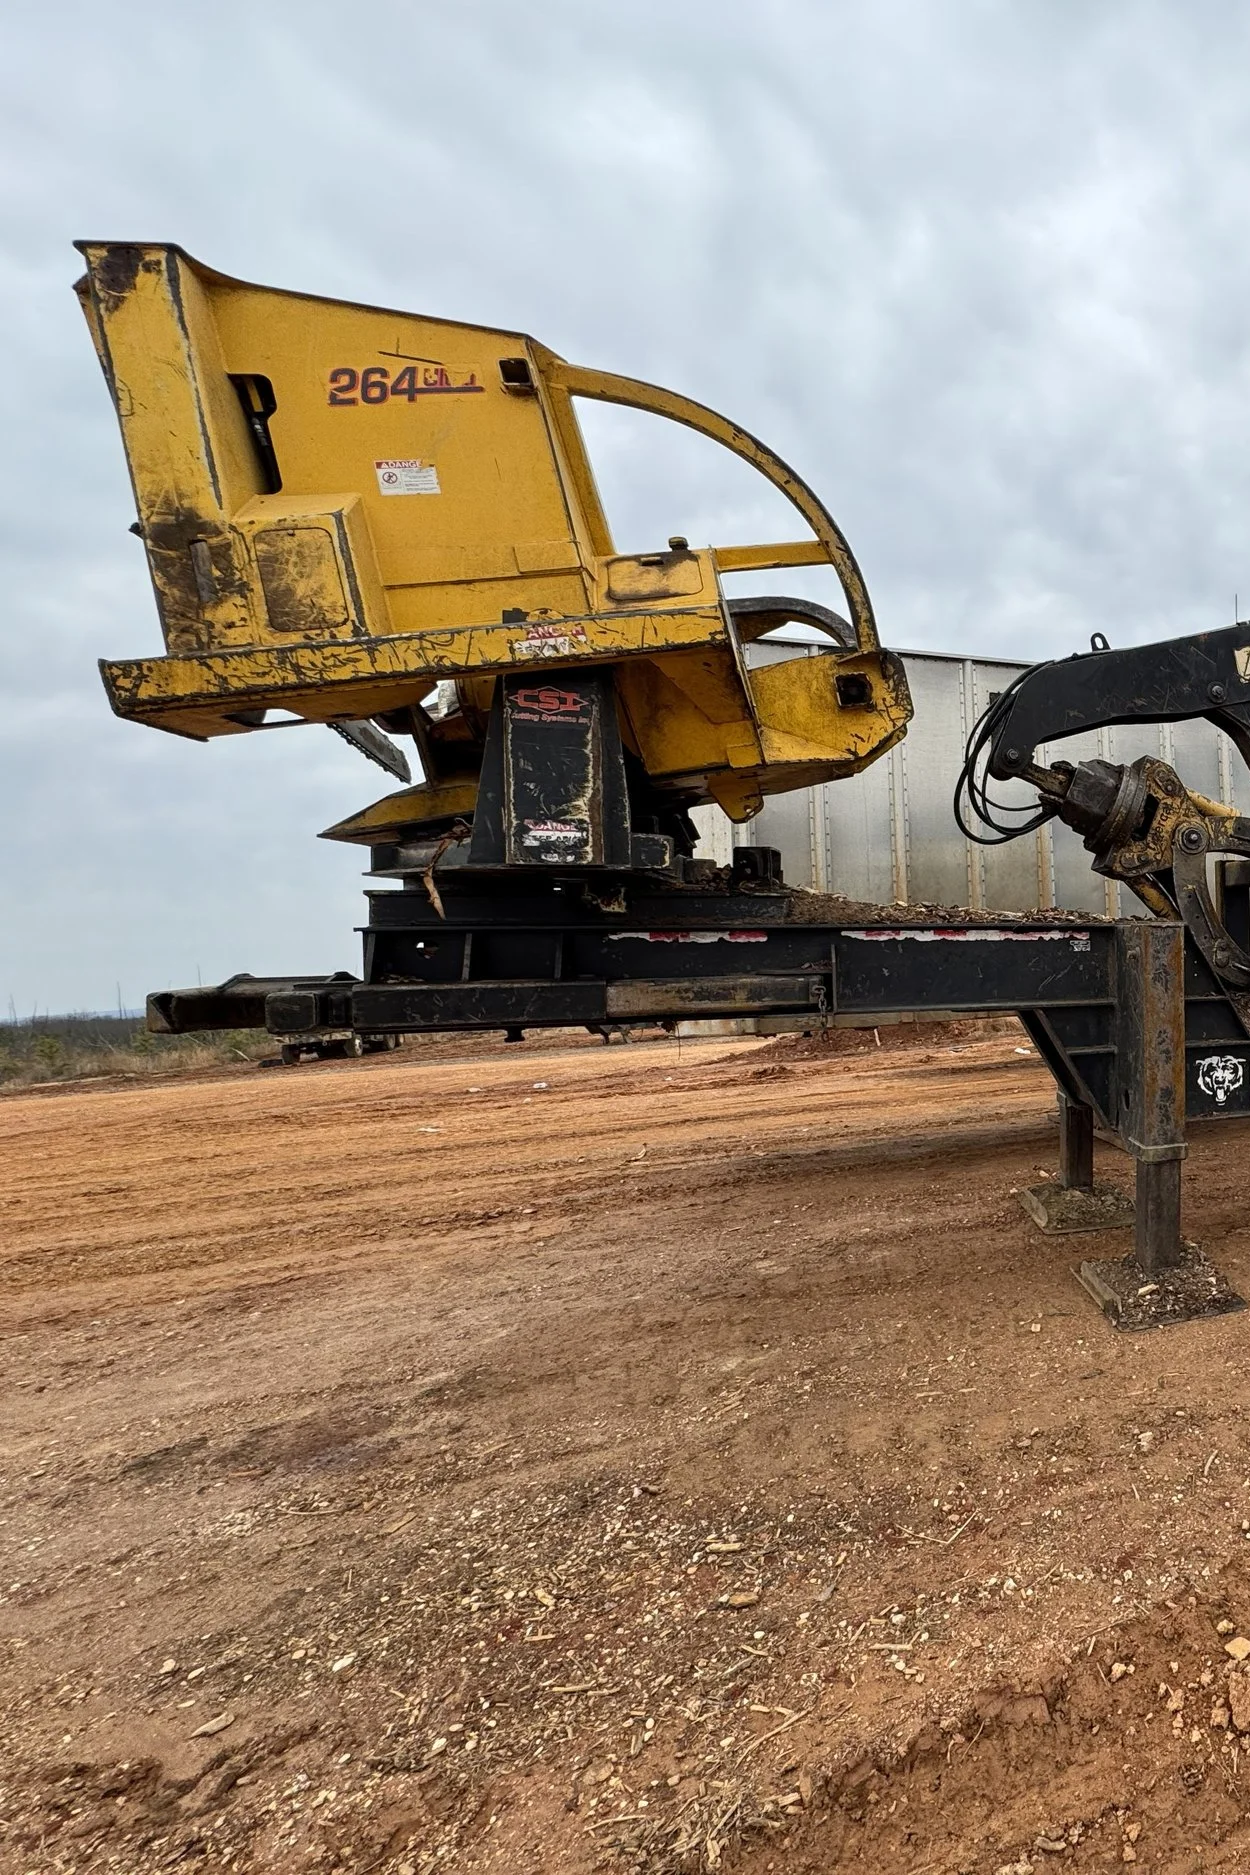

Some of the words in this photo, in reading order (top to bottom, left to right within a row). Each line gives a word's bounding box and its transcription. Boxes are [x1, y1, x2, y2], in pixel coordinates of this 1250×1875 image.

[328, 366, 417, 406] 264
[388, 460, 422, 468] DANGE
[517, 689, 580, 711] CSI
